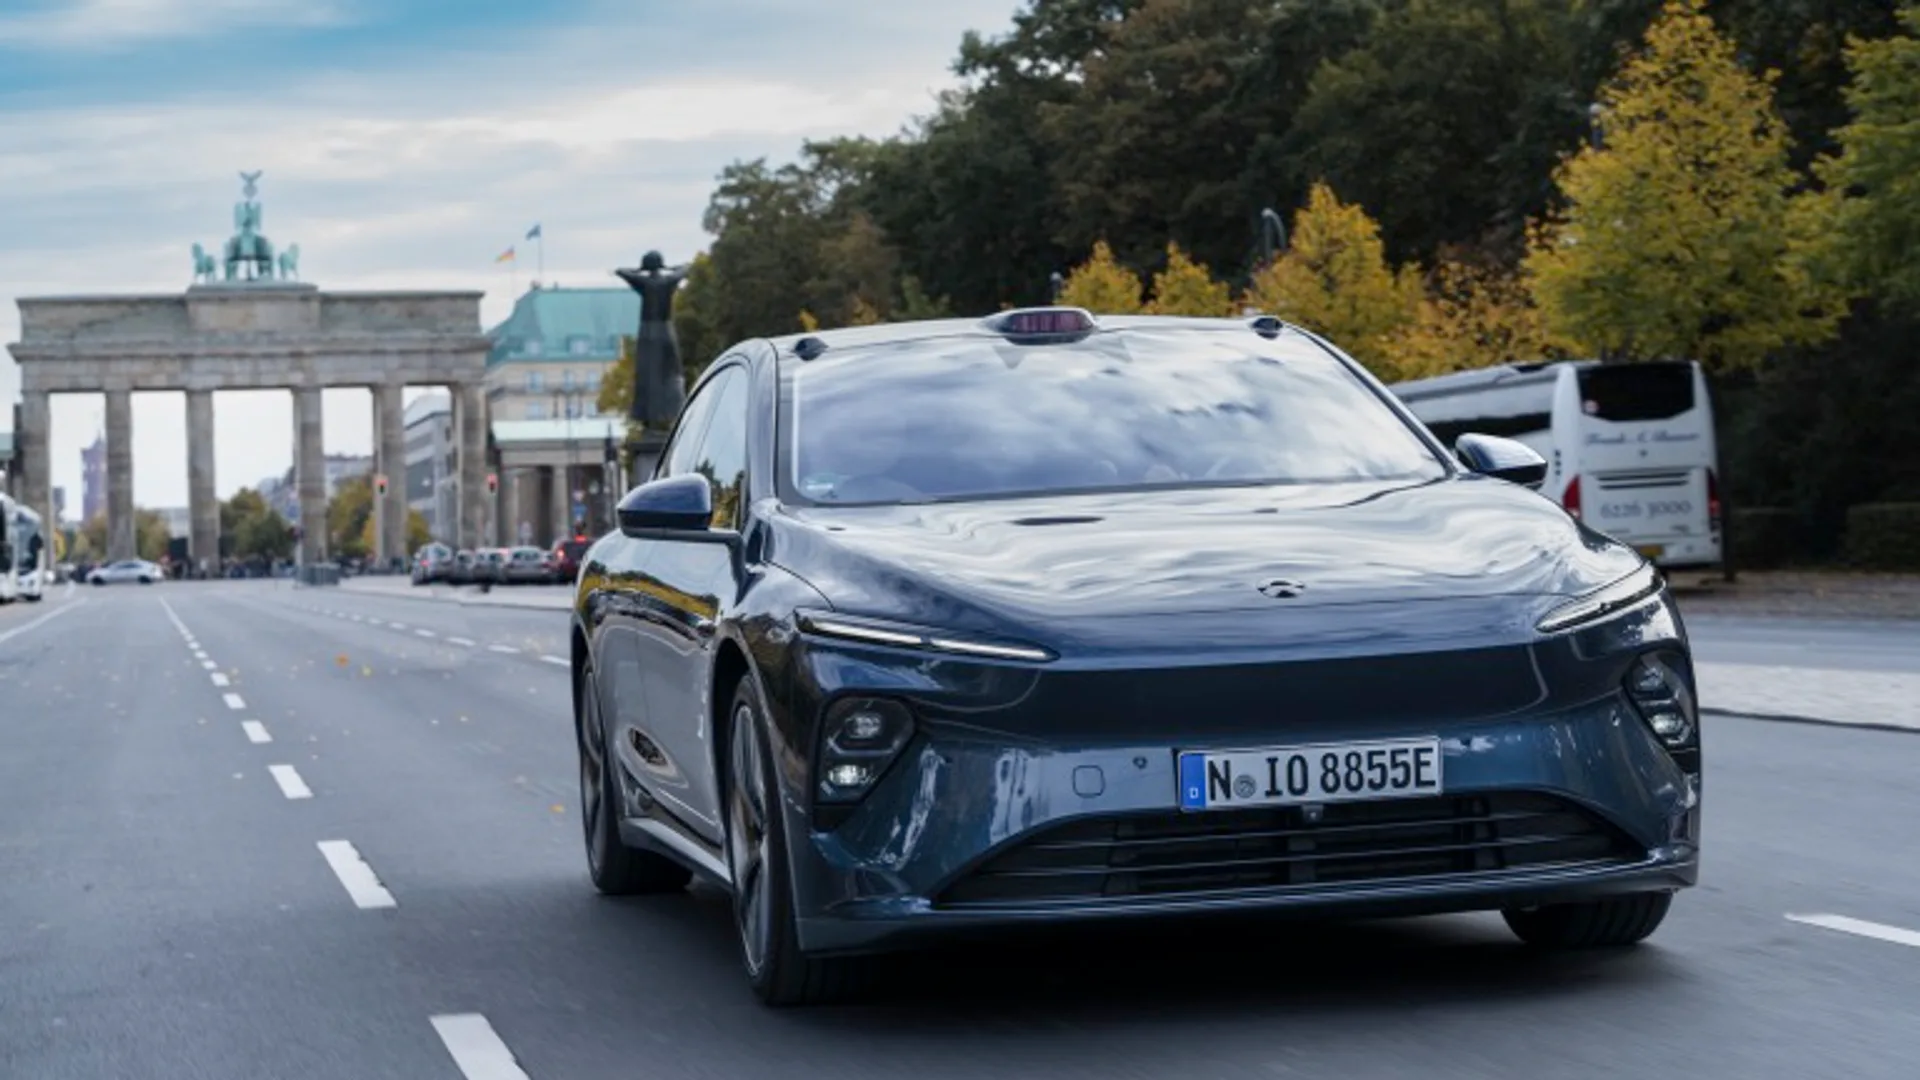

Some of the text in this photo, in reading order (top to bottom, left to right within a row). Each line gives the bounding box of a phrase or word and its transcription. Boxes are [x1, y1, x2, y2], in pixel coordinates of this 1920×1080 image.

[1208, 748, 1436, 800] N IO 8855E
